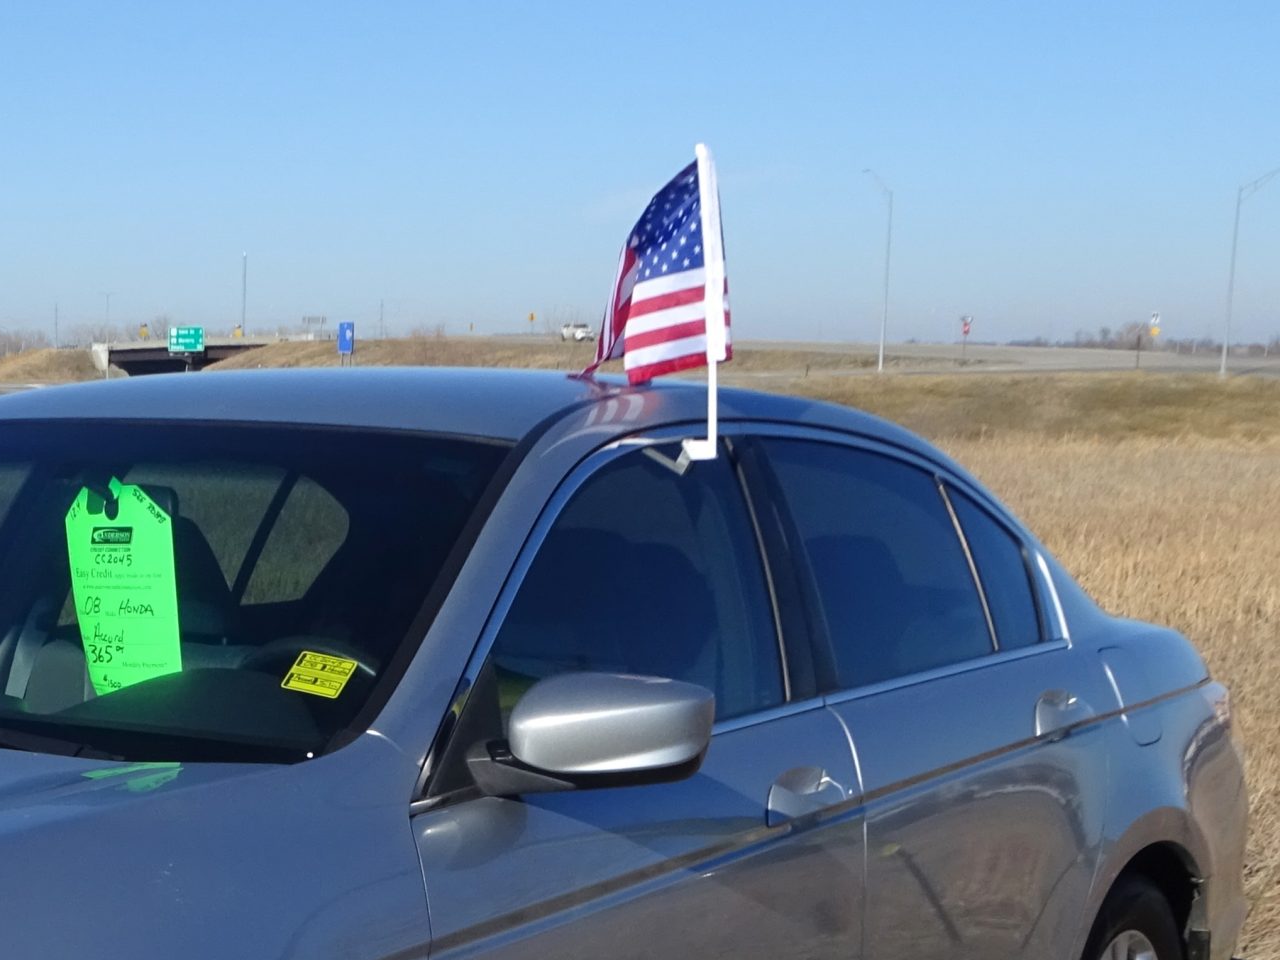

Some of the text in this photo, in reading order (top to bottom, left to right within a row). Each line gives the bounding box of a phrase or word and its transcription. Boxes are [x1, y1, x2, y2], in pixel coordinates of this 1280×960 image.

[95, 554, 133, 567] CC2045
[76, 568, 89, 580] Easy
[91, 568, 113, 578] Credit
[119, 598, 154, 616] HONDA
